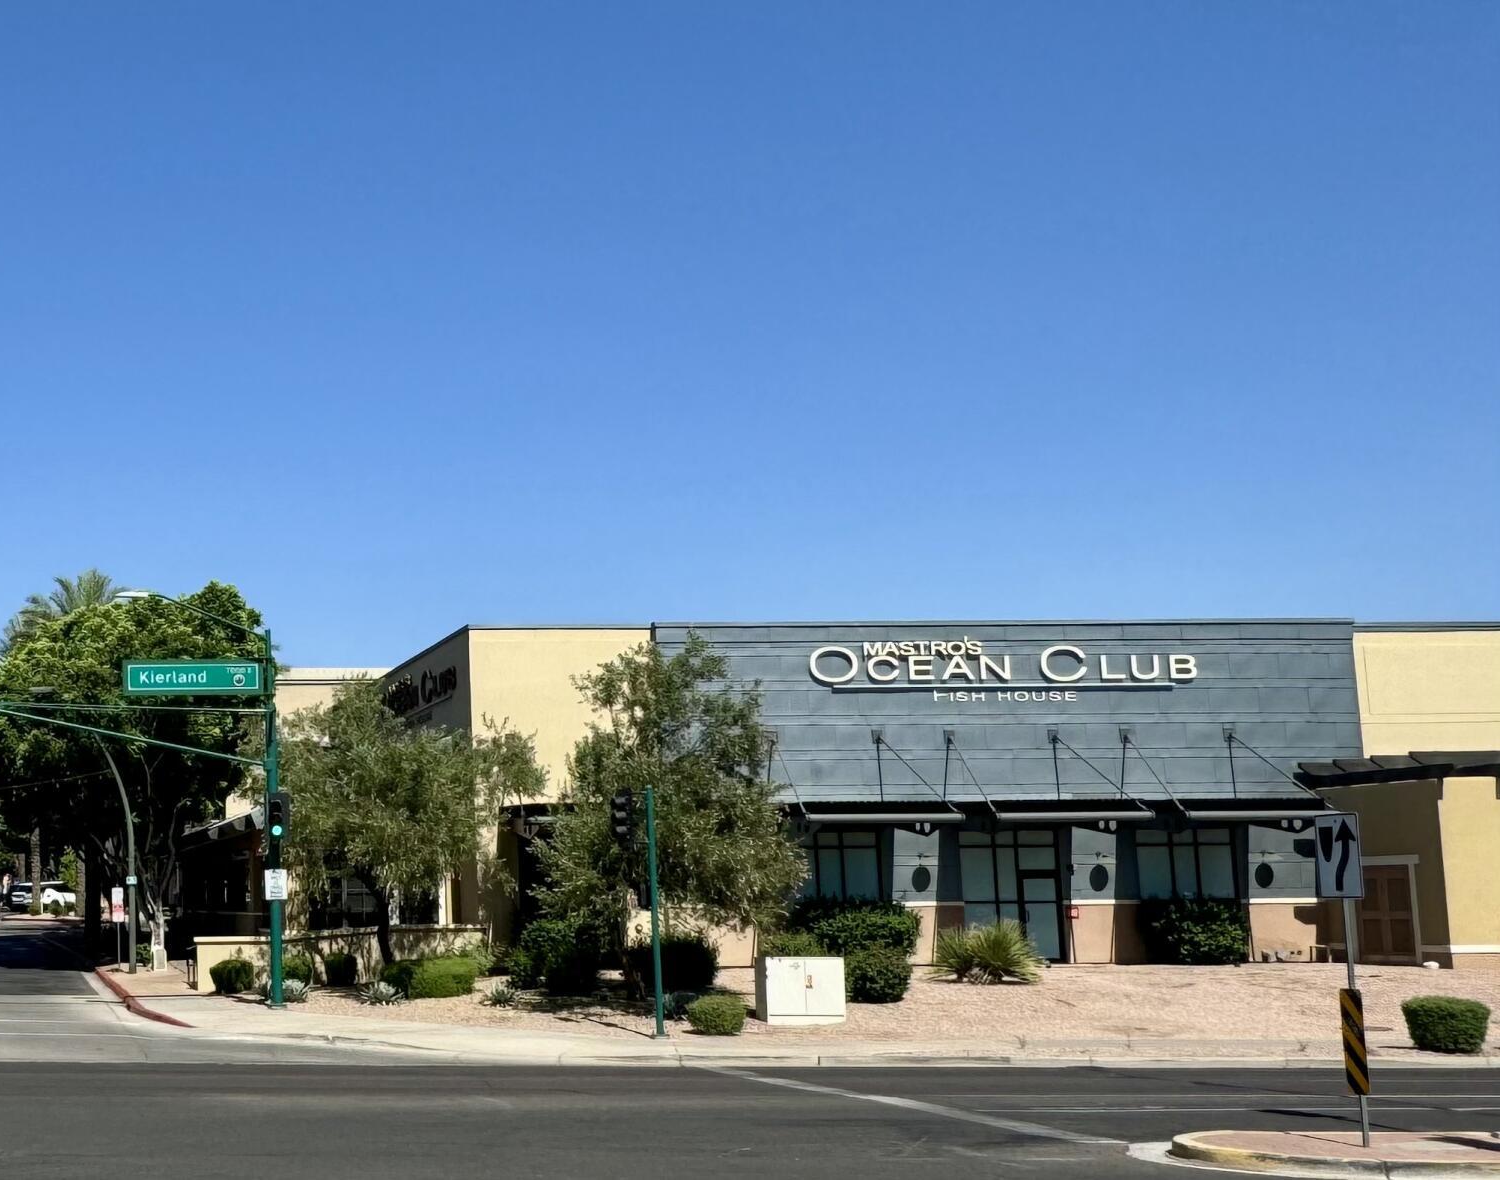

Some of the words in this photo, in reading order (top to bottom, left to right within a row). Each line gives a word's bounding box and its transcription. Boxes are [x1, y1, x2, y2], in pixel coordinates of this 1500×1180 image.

[863, 636, 982, 656] MASTRO'S
[810, 646, 1011, 682] OCEAN
[1040, 645, 1197, 681] CLUB
[140, 671, 207, 684] Kierland
[933, 690, 985, 702] FISH
[998, 690, 1077, 702] HOUSE
